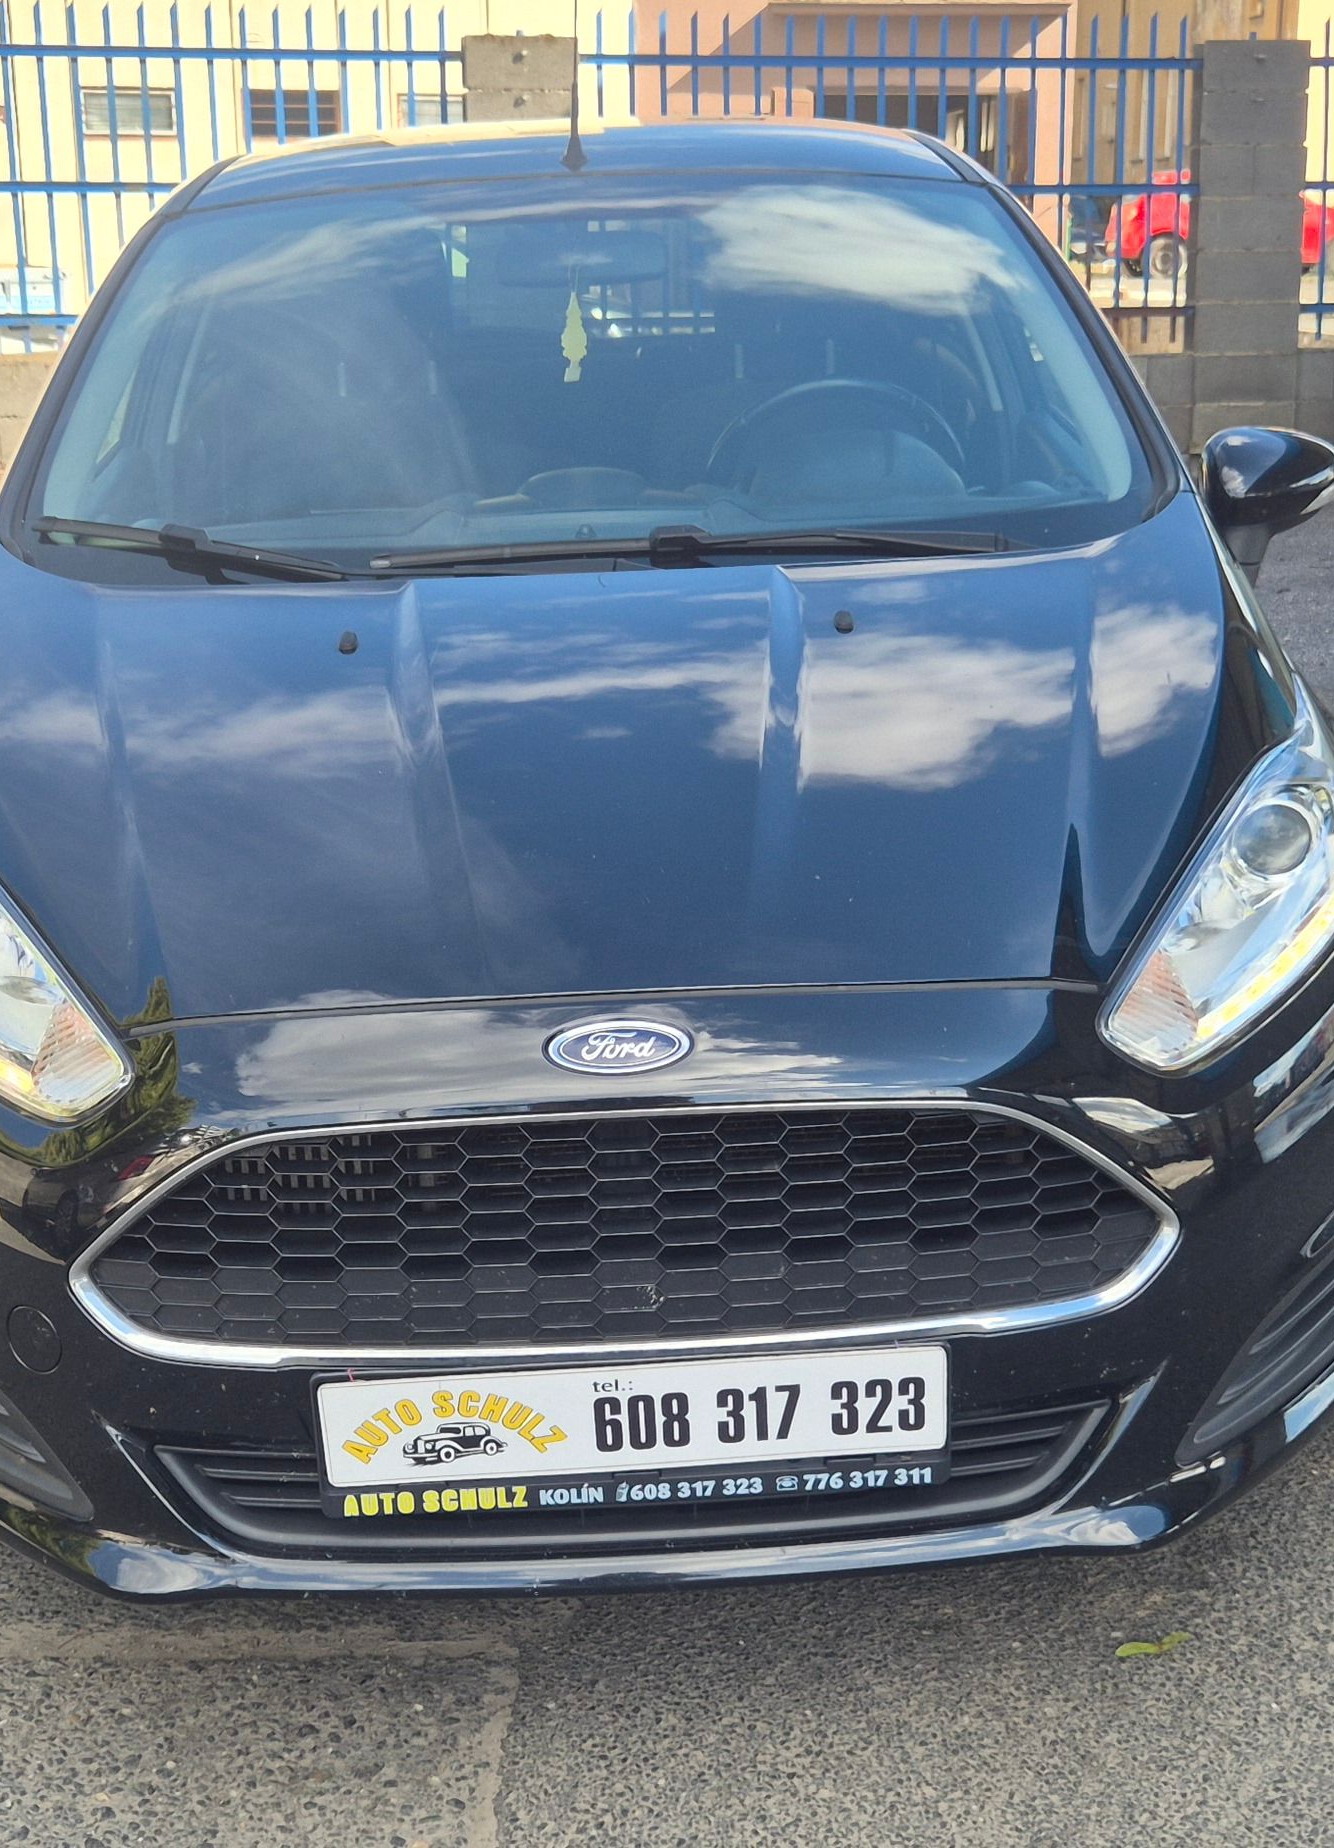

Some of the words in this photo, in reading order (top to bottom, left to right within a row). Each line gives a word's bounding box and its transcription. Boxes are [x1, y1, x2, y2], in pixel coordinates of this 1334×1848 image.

[580, 1031, 657, 1061] Ford
[592, 1378, 634, 1393] tel.:
[341, 1398, 423, 1465] AUTO
[431, 1389, 569, 1454] SCHULZ
[593, 1391, 692, 1453] 608
[716, 1383, 802, 1444] 317
[830, 1376, 926, 1436] 323
[343, 1491, 415, 1517] AUTO
[422, 1485, 529, 1513] SCHULZ
[538, 1482, 605, 1506] KOLÍN
[630, 1482, 672, 1501] 608
[677, 1479, 716, 1499] 317
[722, 1476, 764, 1496] 323
[802, 1471, 844, 1491] 776
[849, 1468, 889, 1489] 317
[893, 1466, 933, 1487] 311
